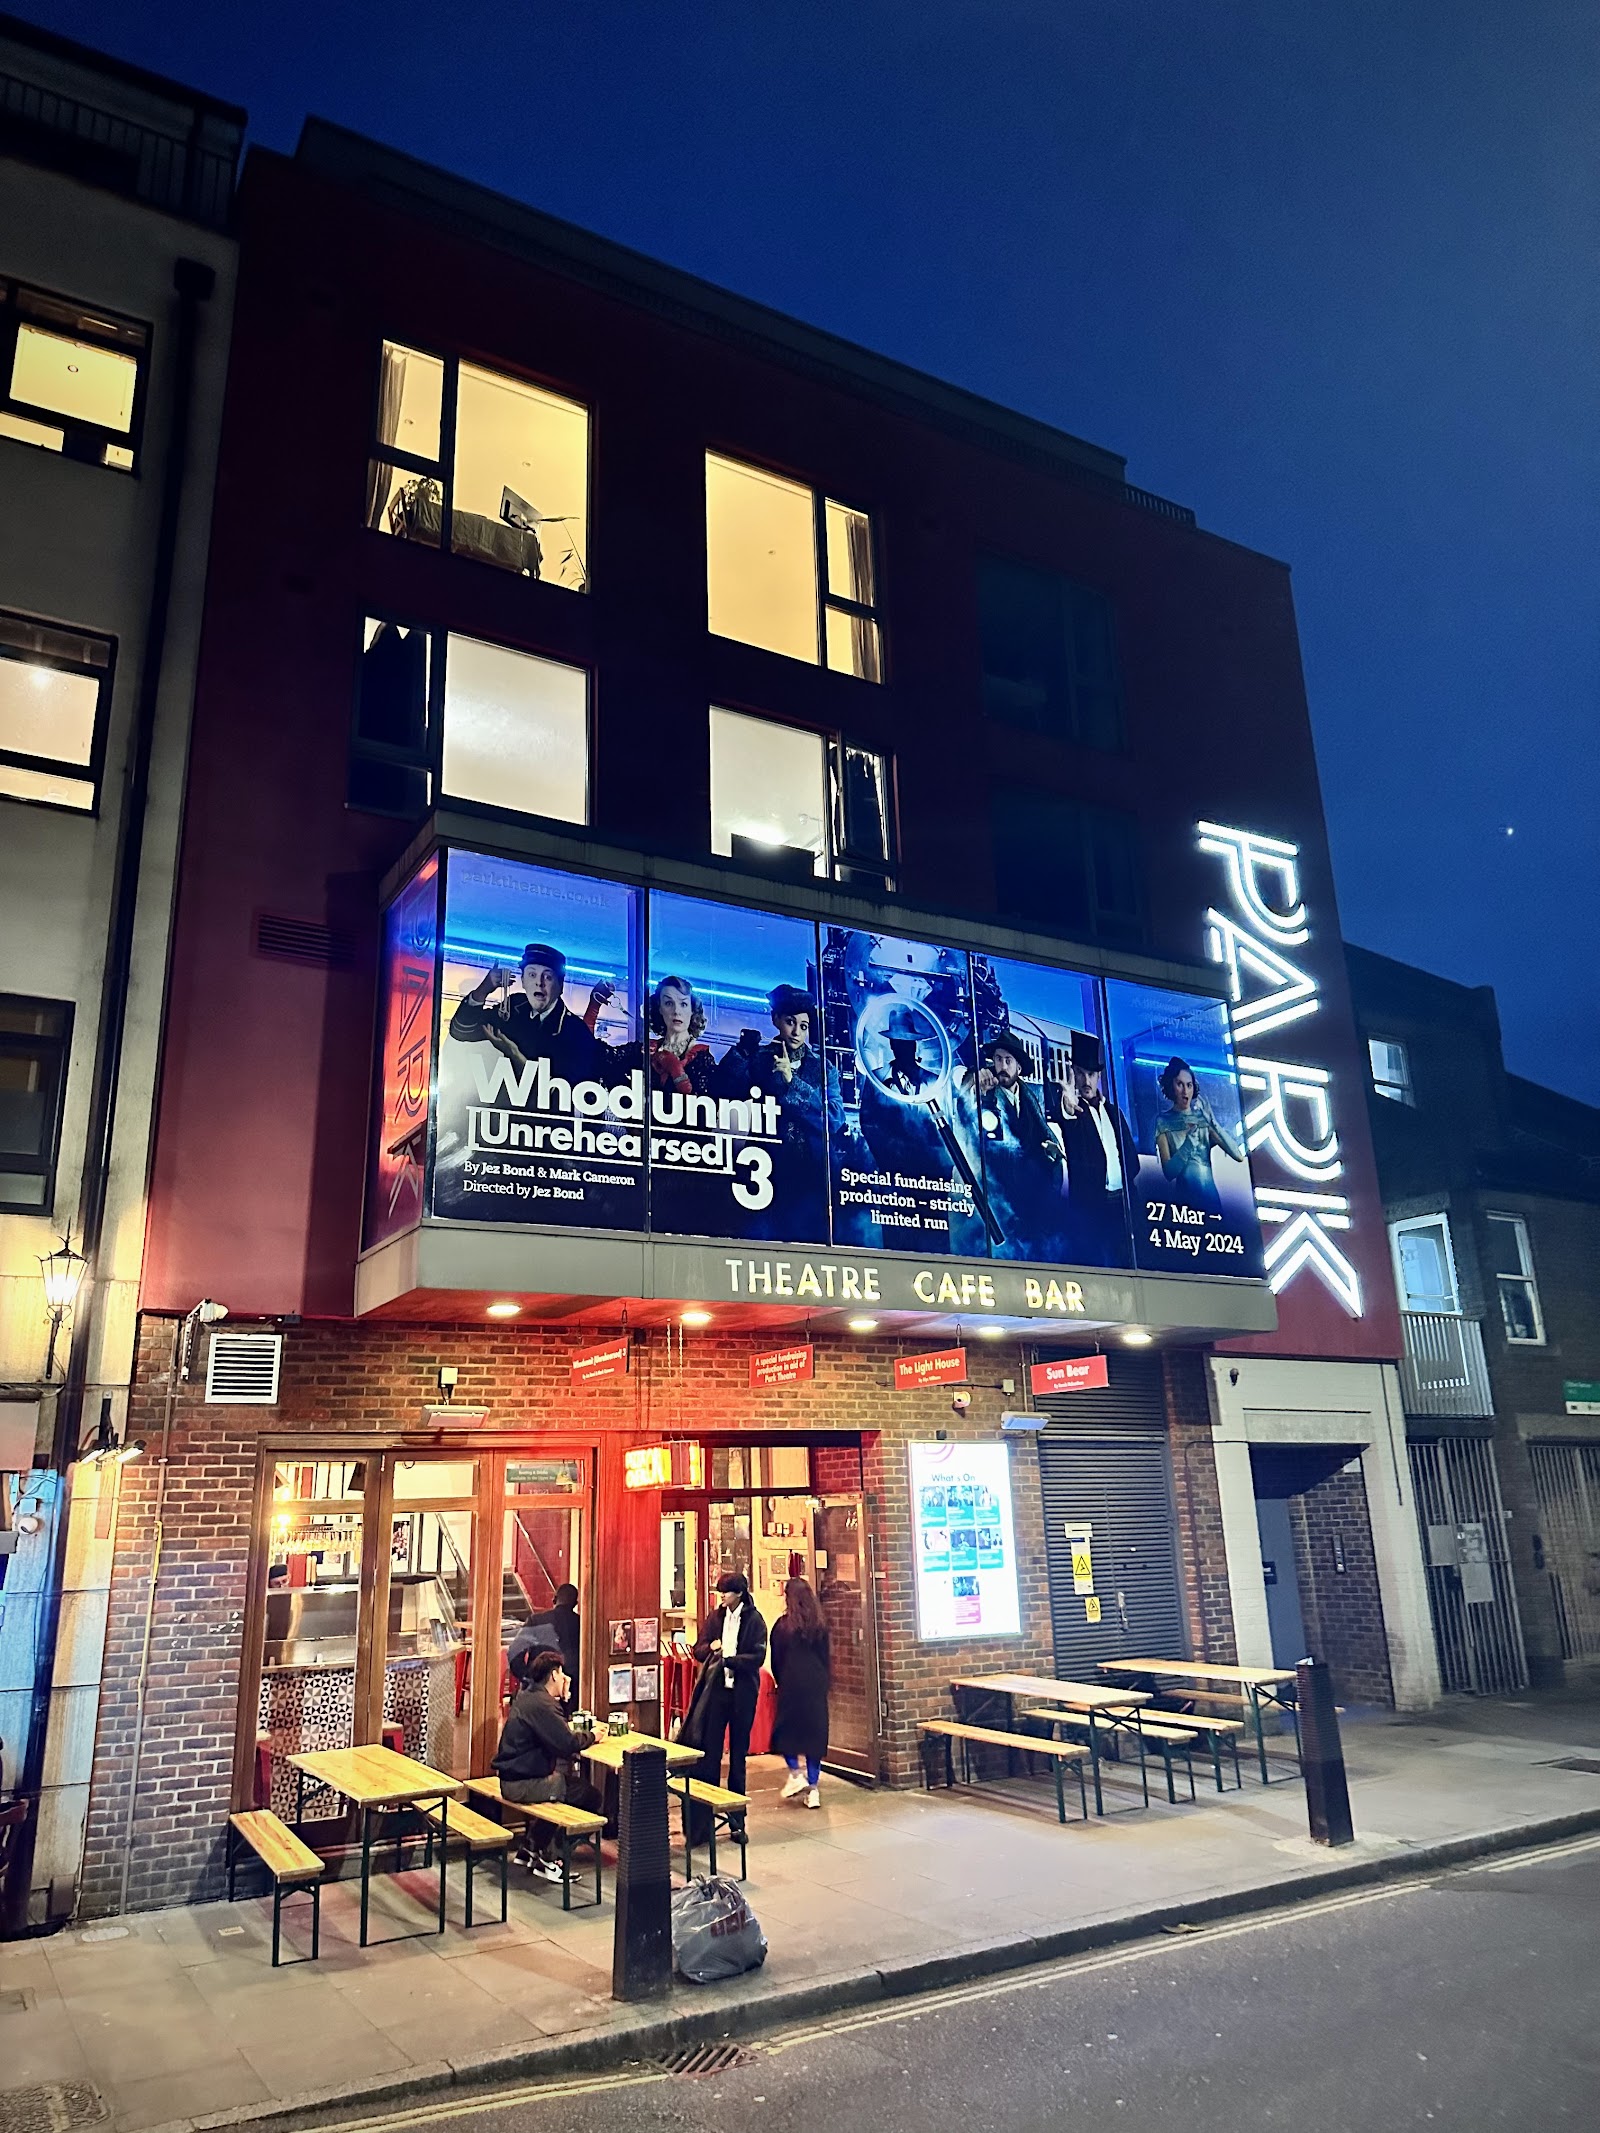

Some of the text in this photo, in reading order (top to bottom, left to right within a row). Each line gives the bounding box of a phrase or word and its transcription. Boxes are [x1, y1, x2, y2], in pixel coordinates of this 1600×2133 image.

[460, 868, 610, 907] parktheatre.co.uk
[1199, 820, 1364, 1319] PARK
[469, 1054, 782, 1135] Whodunnit
[463, 1160, 636, 1186] By Jez Bond & Mark Cameron
[732, 1146, 774, 1210] 3
[841, 1168, 973, 1198] Special fundraising
[463, 1179, 584, 1200] Directed by Jez Bond
[839, 1189, 916, 1208] production
[929, 1197, 975, 1217] strictly
[1146, 1201, 1205, 1225] 27 Mar
[870, 1209, 949, 1230] limited run
[1149, 1228, 1245, 1256] 4 May 2024
[725, 1258, 1086, 1312] THEATRE CAFE BAR
[755, 1350, 808, 1367] A special fundraising
[756, 1358, 806, 1378] production in aid of
[898, 1357, 960, 1376] The Light House
[764, 1370, 797, 1383] Park Theatre
[1046, 1364, 1090, 1380] Sun Bear
[931, 1472, 976, 1482] Whats On
